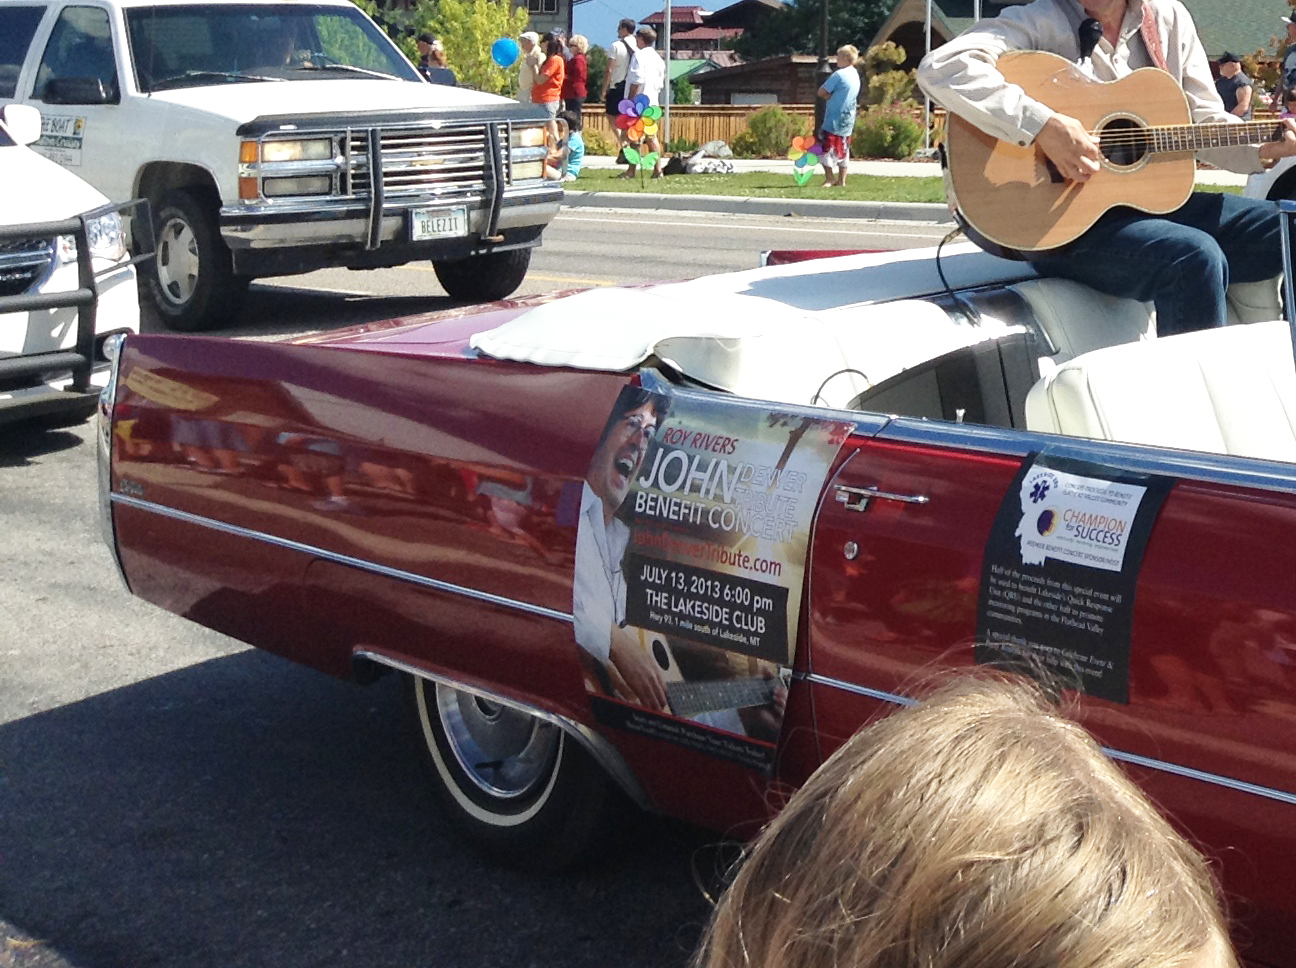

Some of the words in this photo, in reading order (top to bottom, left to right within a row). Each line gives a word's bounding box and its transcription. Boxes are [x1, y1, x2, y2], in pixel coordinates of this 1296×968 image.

[663, 427, 692, 446] ROY
[690, 433, 739, 455] RIVERS
[639, 448, 743, 504] JOHN
[740, 463, 807, 493] DENVER
[635, 491, 706, 525] BENEFIT
[708, 506, 799, 543] CONCERT
[734, 486, 798, 519] TRIBUTE
[1063, 508, 1127, 533] CHAMPION
[1074, 525, 1122, 547] SUCCESS
[640, 564, 669, 585] JULY
[670, 571, 688, 592] 13,
[690, 576, 720, 599] 2013
[723, 584, 750, 606] 6:00
[753, 595, 773, 612] pm
[645, 588, 669, 609] THE
[671, 595, 730, 625] LAKESIDE
[733, 611, 765, 634] CLUB
[650, 611, 663, 624] Hwy
